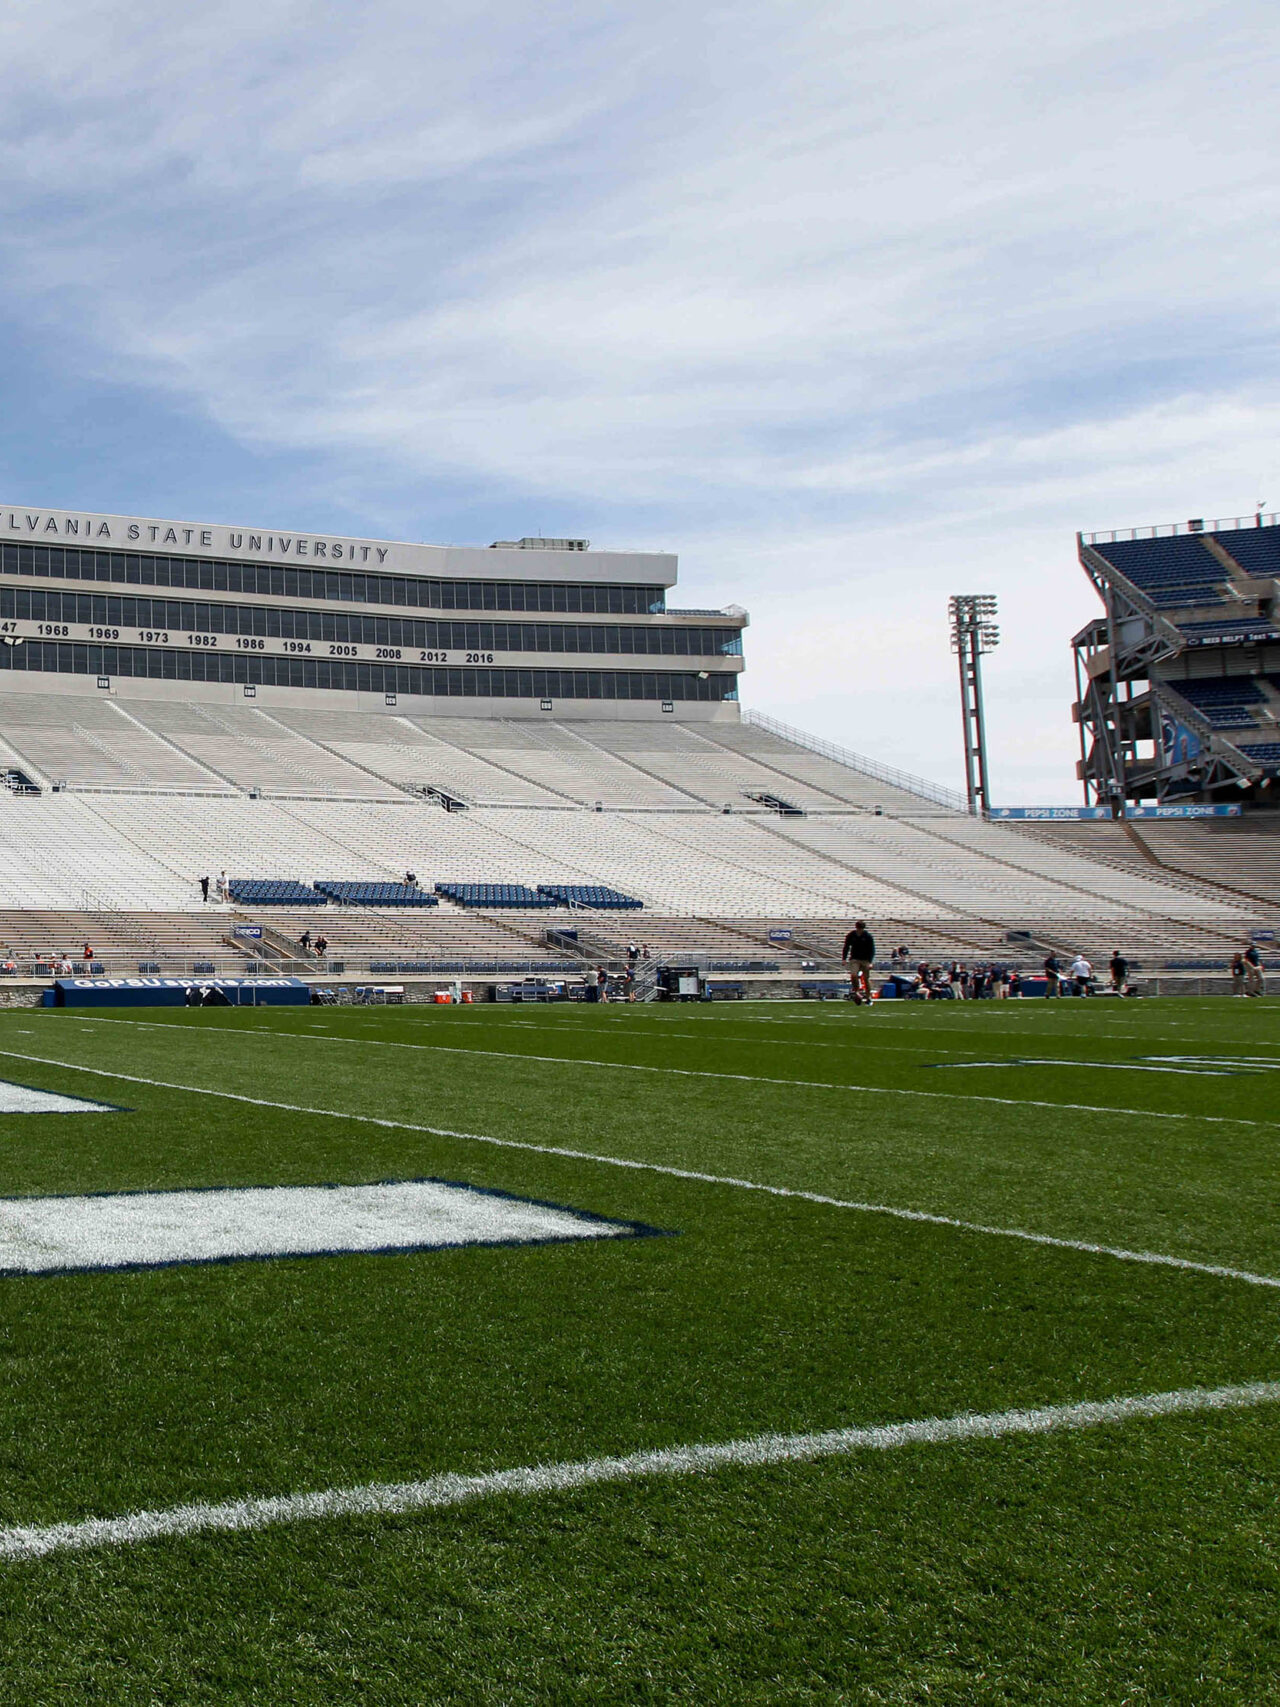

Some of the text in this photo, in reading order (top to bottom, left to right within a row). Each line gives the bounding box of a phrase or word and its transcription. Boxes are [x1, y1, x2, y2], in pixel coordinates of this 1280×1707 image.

[127, 524, 212, 546] STATE
[229, 533, 389, 563] UNIVERSITY
[37, 624, 69, 636] 1968
[88, 627, 120, 640] 1969
[138, 631, 169, 643] 1973
[187, 634, 218, 647] 1982
[235, 638, 265, 650] 1986
[282, 641, 312, 653] 1994
[329, 645, 358, 656] 2005
[376, 648, 402, 659] 2008
[420, 651, 448, 662] 2012
[465, 652, 494, 663] 2016
[1024, 808, 1079, 818] PEPSI ZONE
[1155, 806, 1215, 816] PEPSI ZONE
